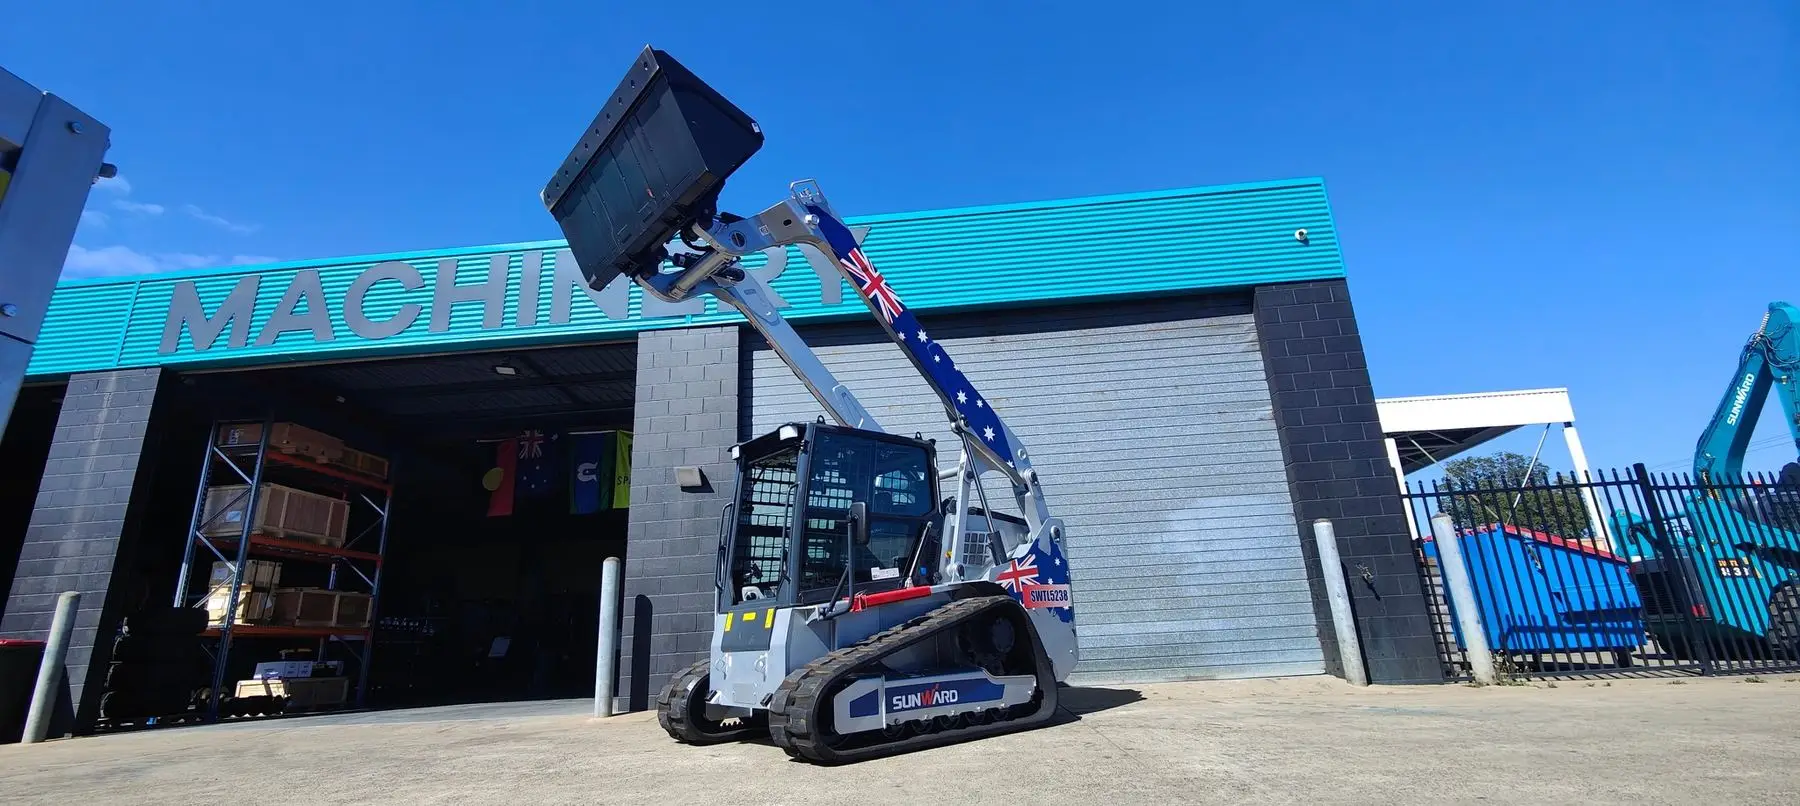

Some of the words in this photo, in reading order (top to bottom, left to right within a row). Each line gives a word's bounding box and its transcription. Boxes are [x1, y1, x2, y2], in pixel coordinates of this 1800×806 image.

[1727, 373, 1755, 426] SUNWARD
[1030, 589, 1069, 602] SWTL5238
[893, 684, 958, 710] SUNWARD
